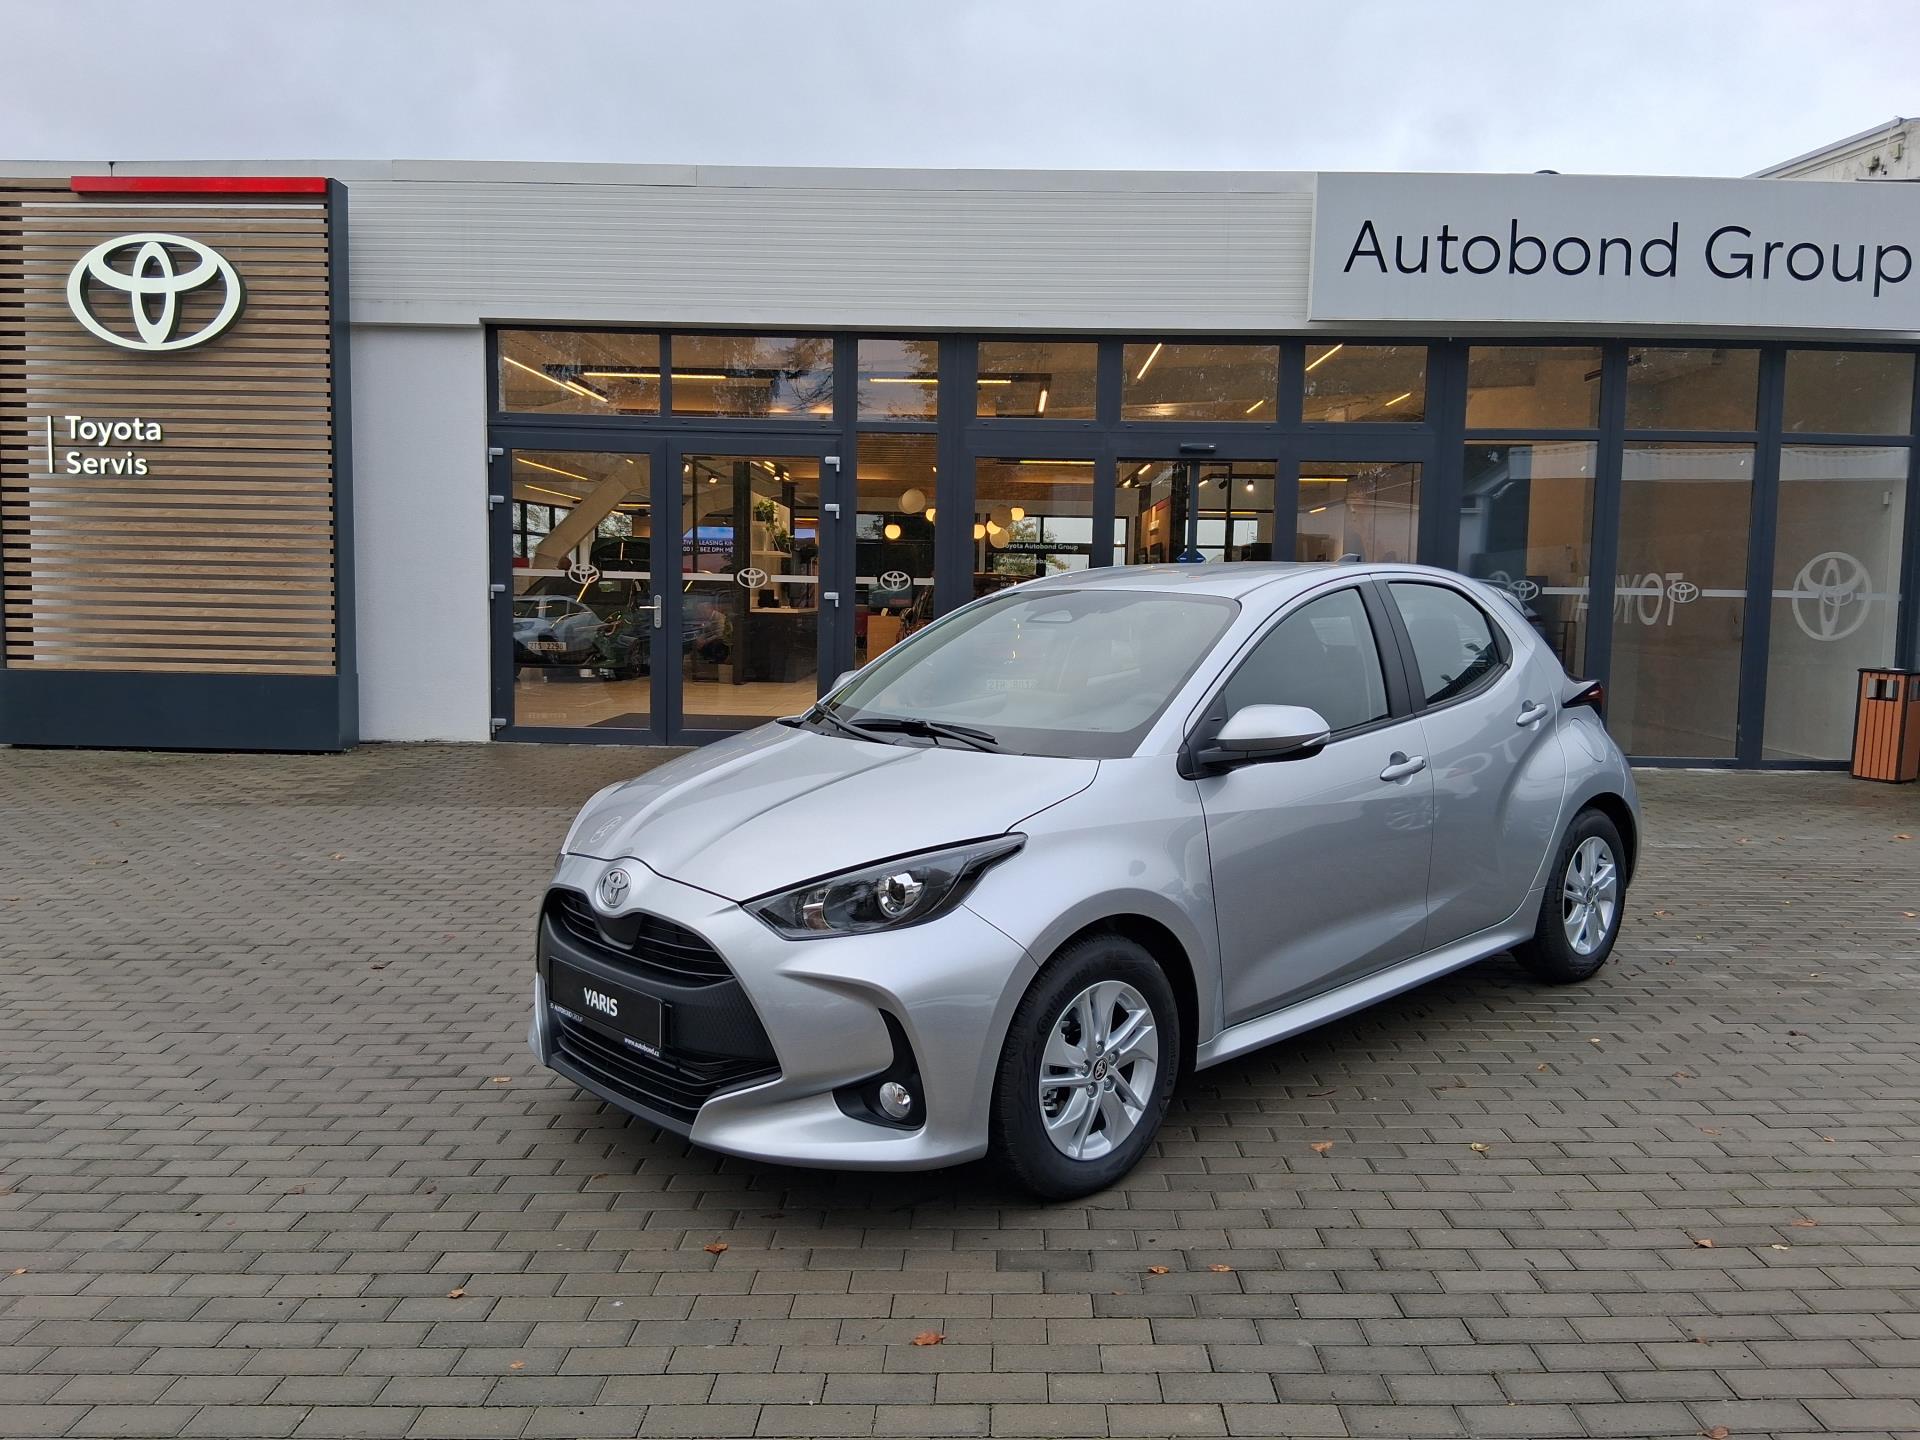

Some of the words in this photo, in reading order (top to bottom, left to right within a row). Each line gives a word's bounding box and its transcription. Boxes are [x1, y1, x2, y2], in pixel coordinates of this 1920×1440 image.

[1343, 218, 1680, 278] Autobond
[1704, 225, 1913, 298] Group
[65, 416, 162, 446] Toyota
[66, 451, 149, 476] Servis
[1058, 543, 1079, 551] Group
[583, 986, 619, 1017] YARIS
